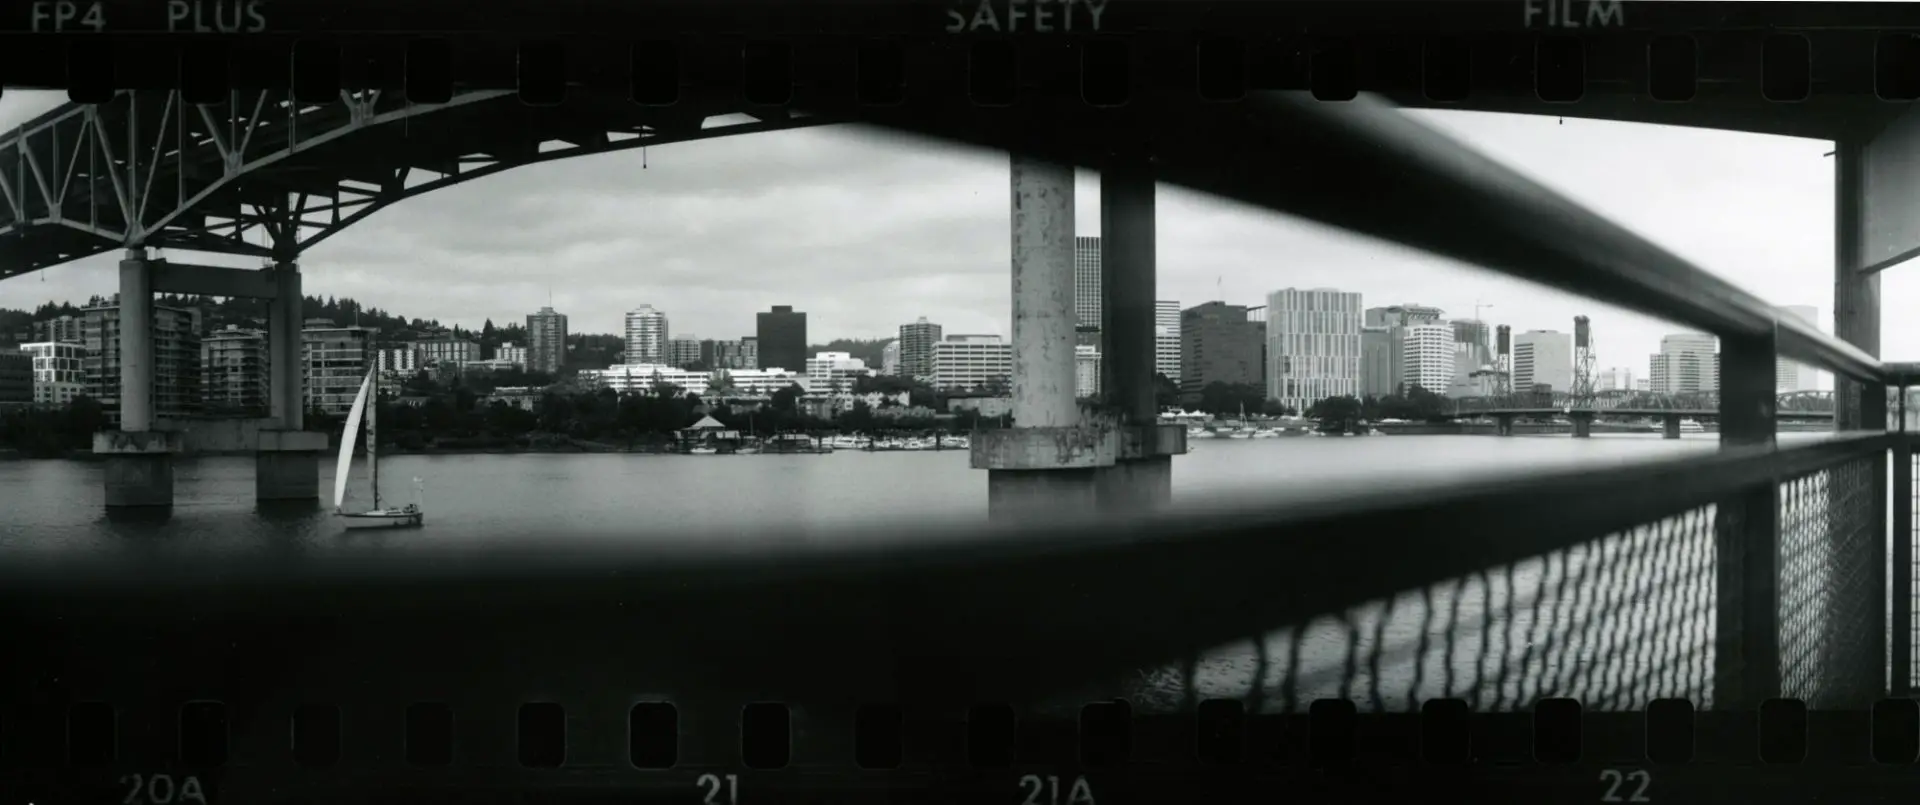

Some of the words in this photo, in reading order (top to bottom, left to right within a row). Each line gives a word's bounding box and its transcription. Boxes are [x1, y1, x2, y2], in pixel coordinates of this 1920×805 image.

[31, 2, 106, 33] FP4
[168, 0, 266, 33] PLUS
[945, 1, 1109, 31] SAFETY
[1523, 1, 1624, 28] FILM
[119, 773, 207, 804] 20A
[697, 774, 738, 805] 21
[1019, 774, 1094, 805] 21A
[1600, 770, 1651, 802] 22
